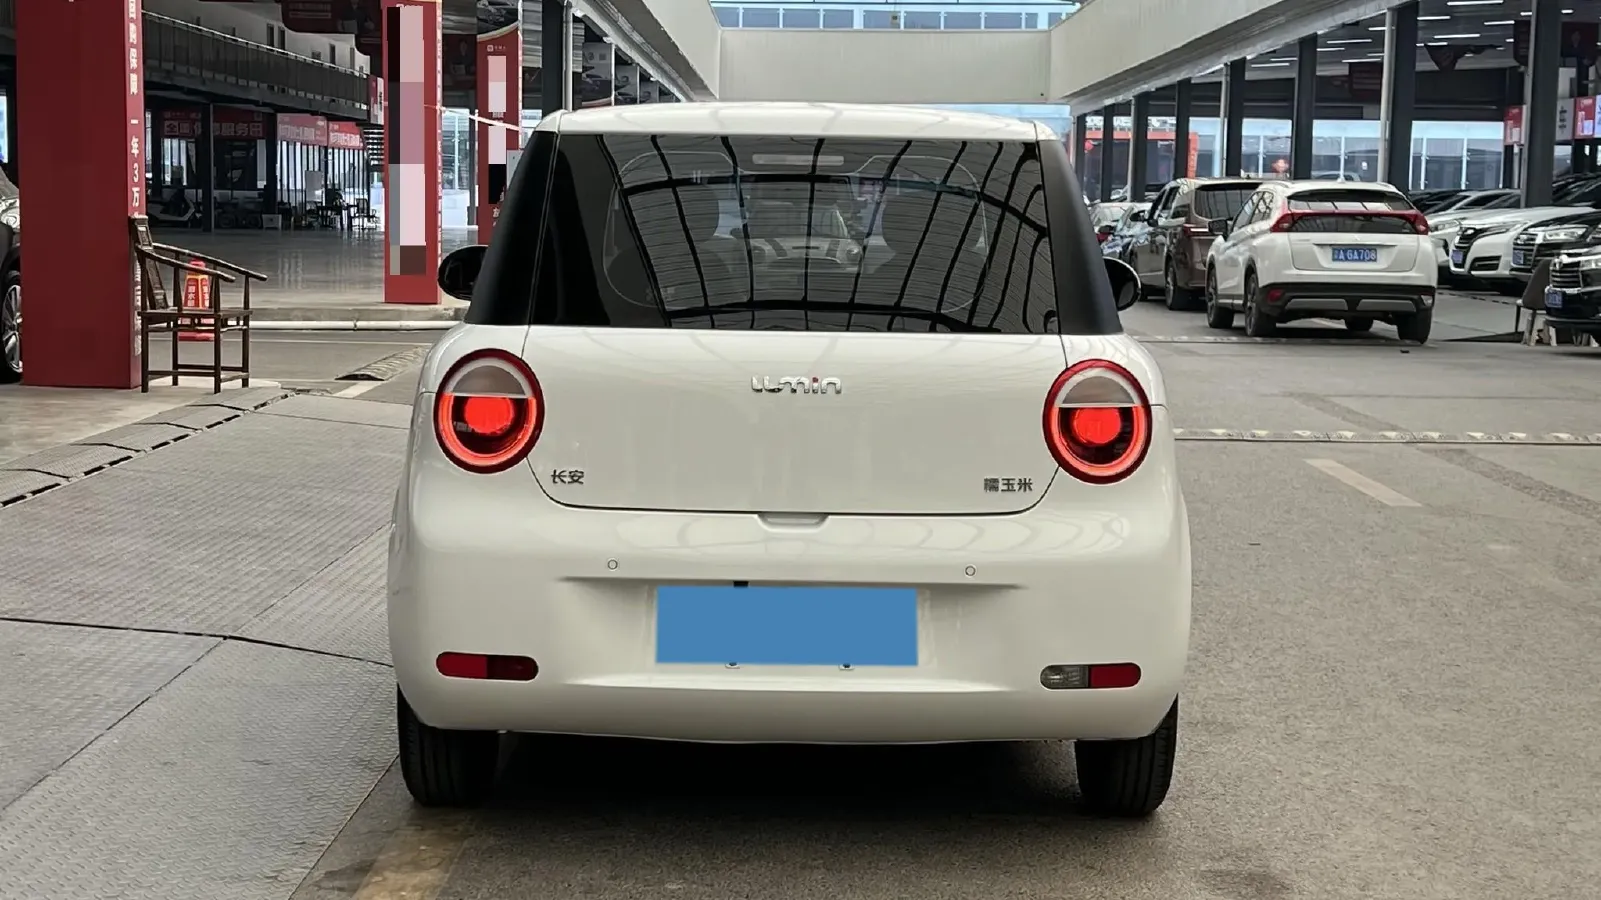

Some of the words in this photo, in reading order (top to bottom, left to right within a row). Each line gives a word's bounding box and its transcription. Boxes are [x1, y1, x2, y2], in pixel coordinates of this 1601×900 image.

[550, 468, 585, 485] 长安
[983, 477, 1033, 493] 糯玉米
